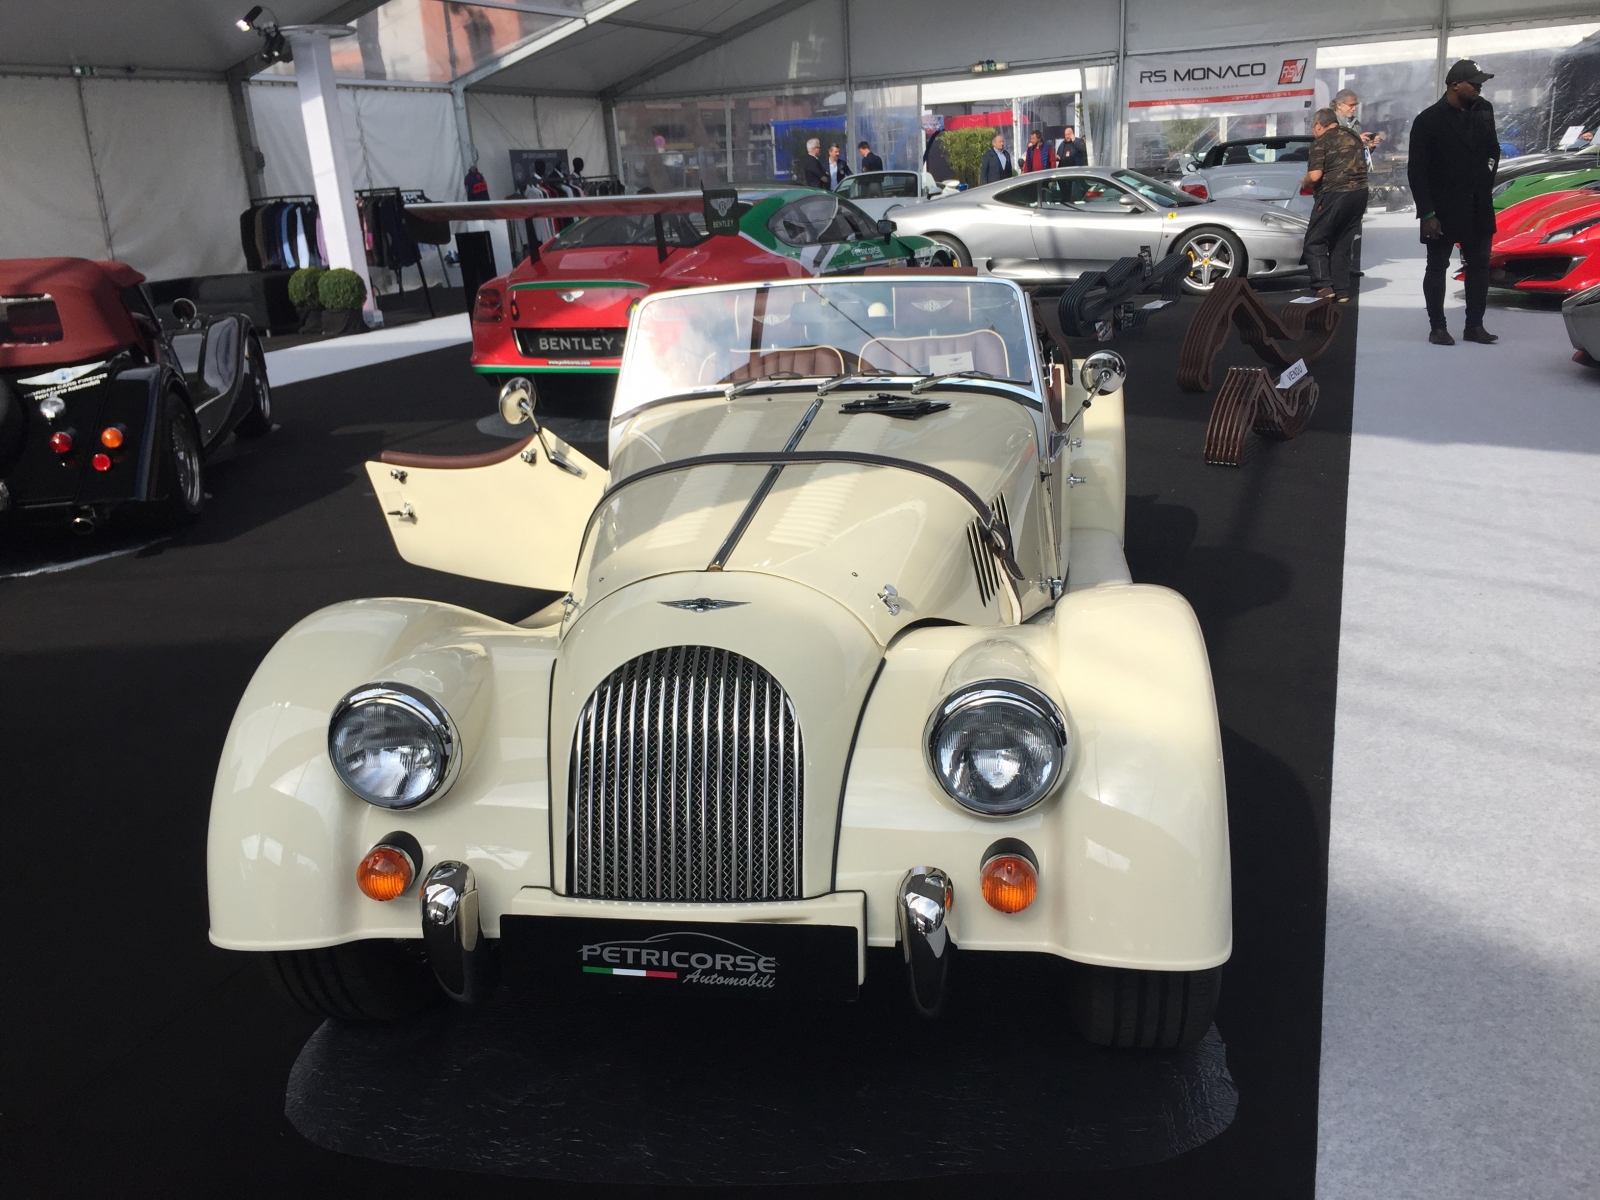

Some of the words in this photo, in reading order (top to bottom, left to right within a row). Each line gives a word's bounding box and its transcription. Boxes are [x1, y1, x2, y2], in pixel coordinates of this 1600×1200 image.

[1139, 70, 1167, 84] RS
[1173, 62, 1266, 82] MONACO
[1281, 64, 1304, 78] RSM
[713, 220, 734, 229] BENTLEY
[539, 337, 614, 351] BENTLEY
[1286, 364, 1303, 381] VENDU
[582, 945, 776, 973] PETRICORSE
[682, 968, 776, 988] Automobili
